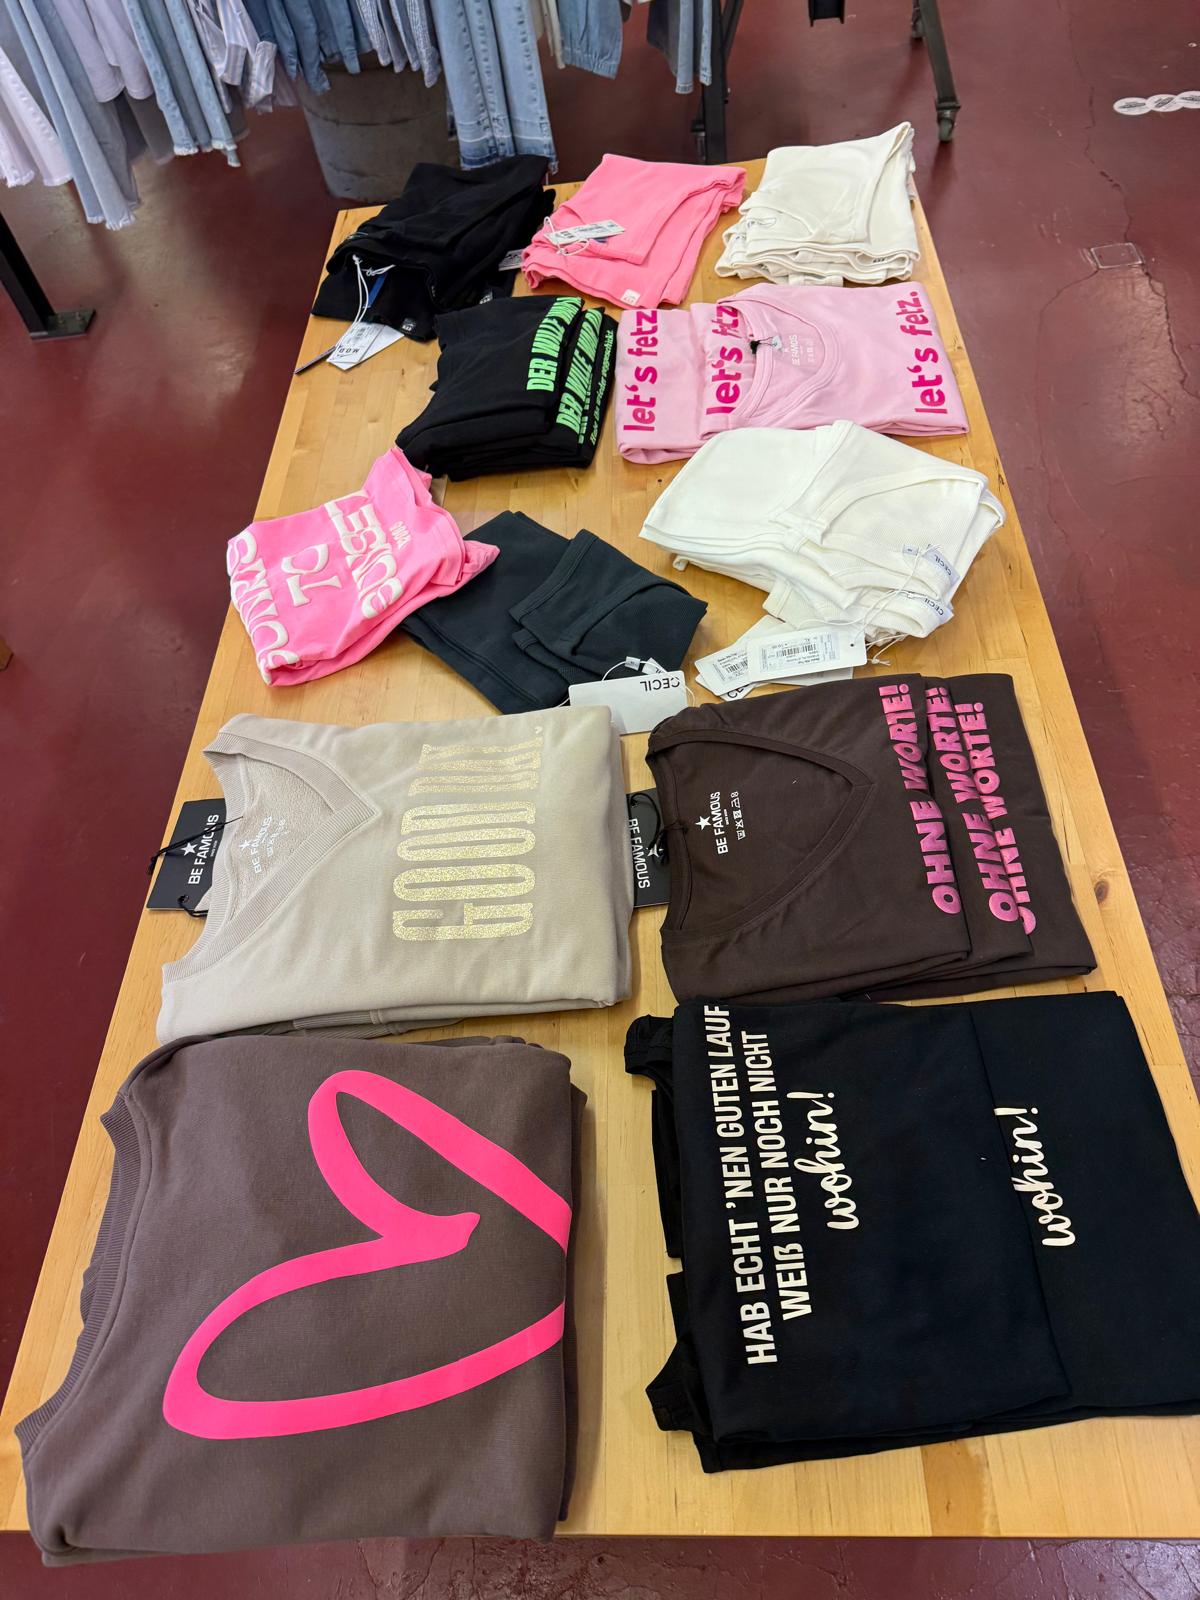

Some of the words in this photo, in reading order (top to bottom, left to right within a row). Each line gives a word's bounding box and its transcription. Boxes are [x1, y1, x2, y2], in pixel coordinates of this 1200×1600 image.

[531, 317, 566, 358] WILLE
[896, 291, 933, 336] fetz.
[526, 358, 558, 392] DER
[565, 349, 593, 401] WILLE
[623, 366, 658, 432] let's
[706, 346, 743, 416] let's
[907, 347, 948, 414] let's
[556, 392, 583, 434] DER
[281, 543, 343, 608] TO
[934, 554, 952, 576] CECIL
[640, 676, 681, 692] CECIL
[878, 683, 929, 791] WORTE!
[925, 686, 980, 804] WORTE!
[954, 702, 1008, 820] WORTE!
[710, 791, 725, 837] FAMOUS
[717, 833, 729, 855] BE
[188, 867, 203, 885] BE
[252, 855, 262, 874] BE
[392, 800, 537, 941] GOOD
[631, 836, 651, 889] FAMOUS
[909, 800, 961, 915] OHNE
[962, 812, 1020, 922] OHNE
[703, 1004, 733, 1058] LAUF
[741, 1030, 778, 1094] NICHT
[710, 1063, 745, 1137] GUTEN
[751, 1099, 790, 1169] NOCH
[787, 1091, 860, 1230] wohin!
[719, 1146, 754, 1210] 'NEN
[764, 1175, 801, 1235] NUR
[994, 1106, 1077, 1248] wohin!
[728, 1218, 766, 1293] ECHT
[772, 1244, 813, 1322] WEIß
[740, 1300, 778, 1366] HAB
